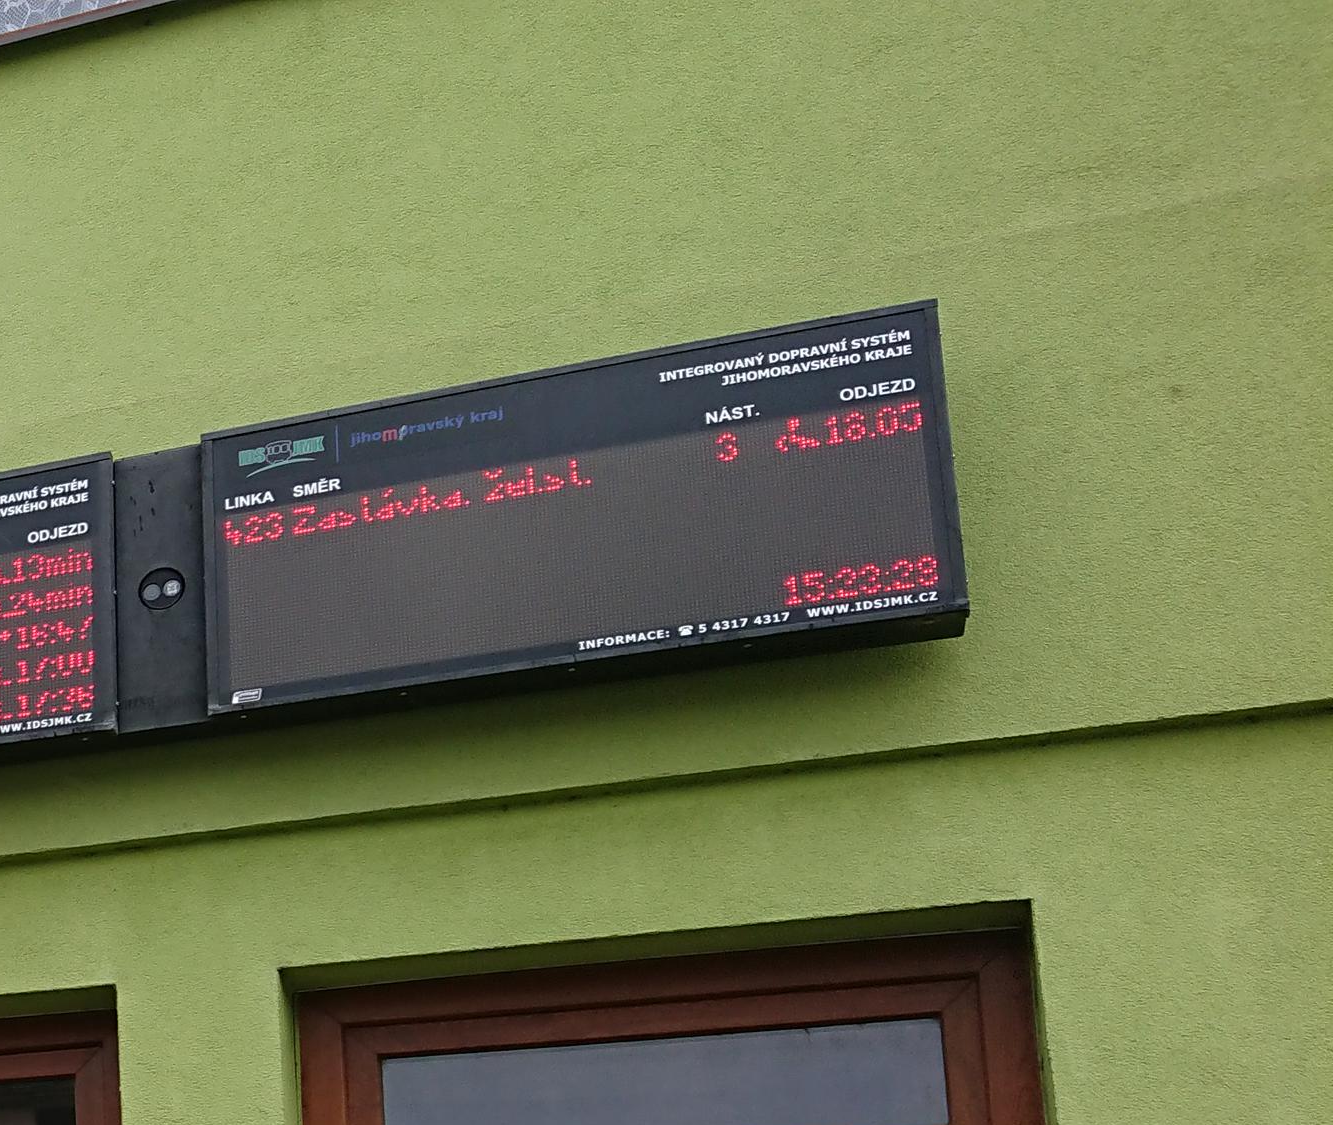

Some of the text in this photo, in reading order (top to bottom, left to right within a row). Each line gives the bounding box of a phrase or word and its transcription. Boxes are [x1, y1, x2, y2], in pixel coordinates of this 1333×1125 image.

[659, 329, 911, 383] INTEGROVANÝ DOPRAVNÍ SYSTÉM
[721, 344, 912, 386] JIHOMORAVSKÉHO KRAJE
[839, 378, 916, 401] ODJEZD
[350, 406, 504, 448] jihomoravský kraj
[705, 404, 760, 425] NÁST.
[714, 431, 739, 463] 3
[40, 478, 88, 497] SYSTÉM
[50, 492, 88, 508] KRAJE
[224, 478, 342, 510] LINKA SMĚR
[27, 522, 88, 544] ODJEZD
[223, 512, 284, 546] 423
[578, 591, 939, 650] INFORMACE: 5 4317 4317 WWW.IDSJMK.CZ
